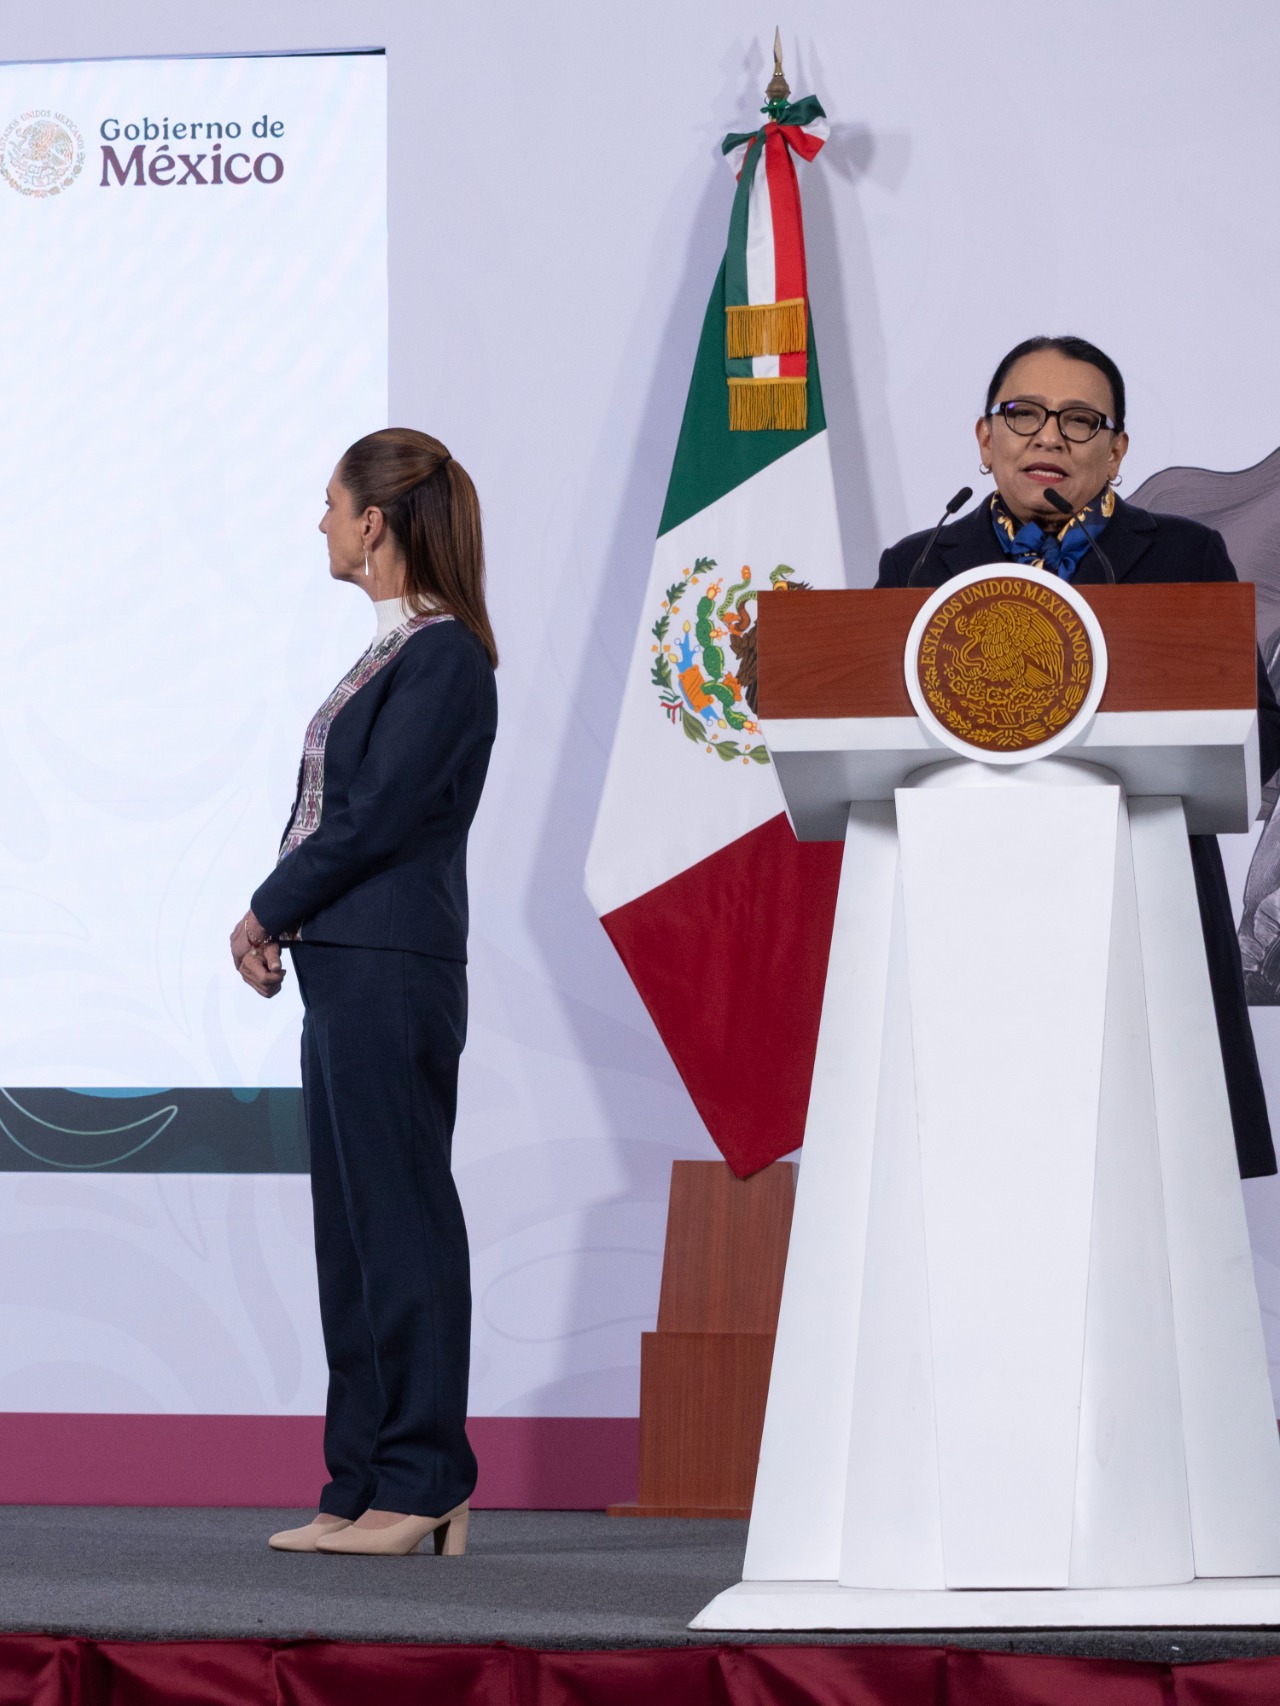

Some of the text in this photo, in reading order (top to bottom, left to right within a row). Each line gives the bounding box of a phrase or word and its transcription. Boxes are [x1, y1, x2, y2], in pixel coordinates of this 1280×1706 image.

[100, 115, 284, 141] Gobierno de
[100, 143, 284, 186] México
[921, 580, 1088, 665] ESTADOS UNIDOS MEXICANOS
